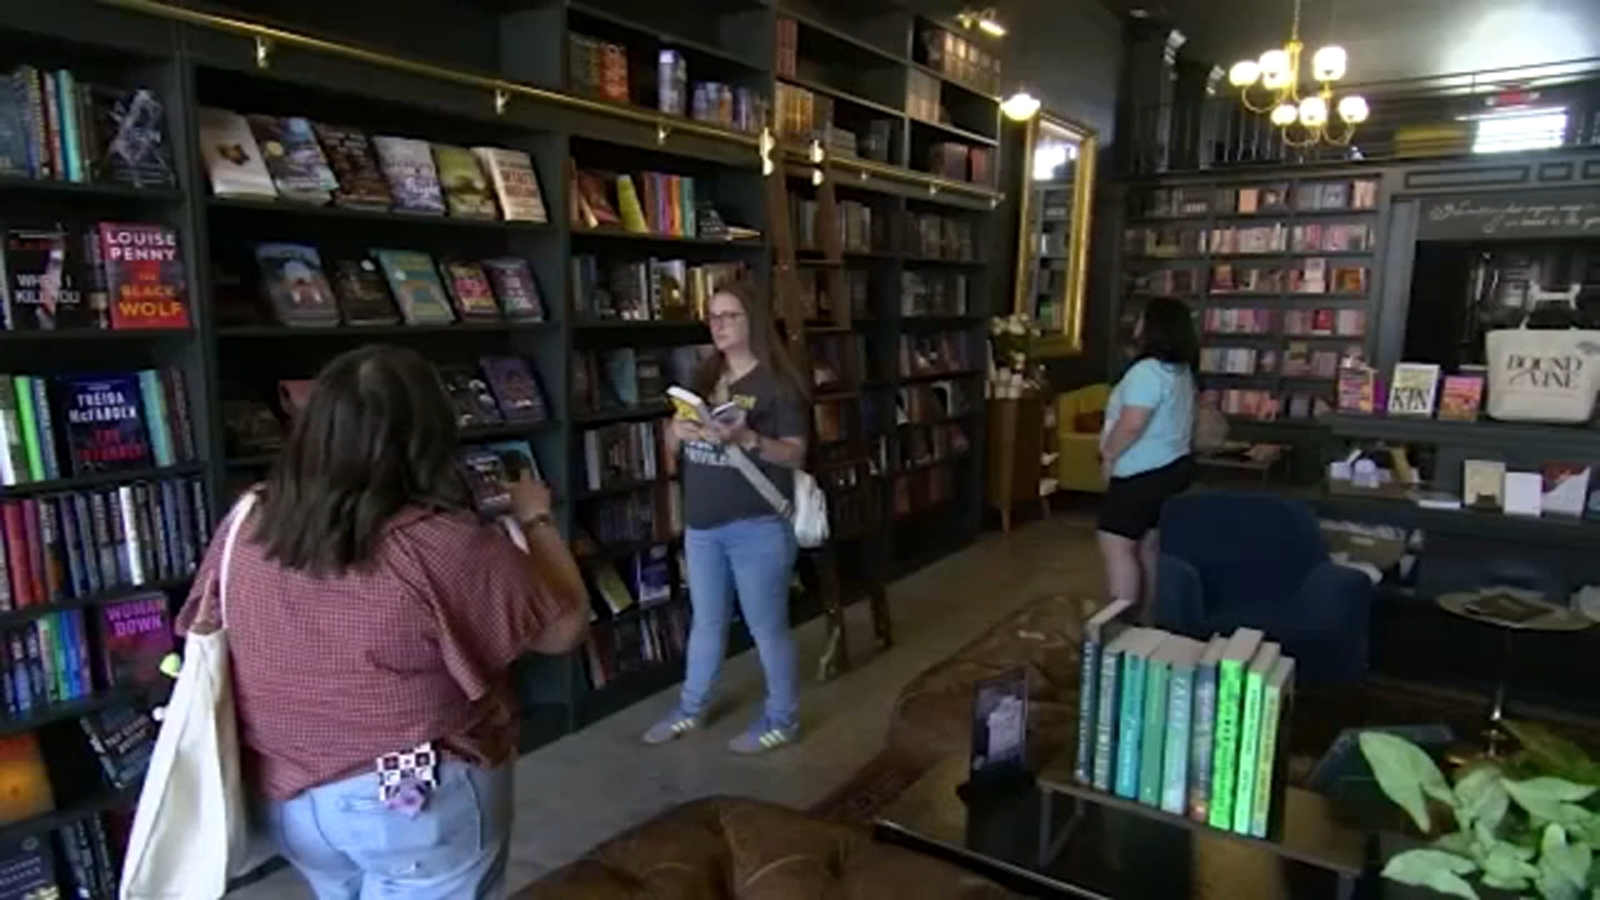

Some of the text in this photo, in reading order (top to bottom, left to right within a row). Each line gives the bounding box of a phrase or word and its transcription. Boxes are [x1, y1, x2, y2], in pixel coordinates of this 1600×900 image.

[105, 230, 176, 246] LOUISE
[110, 247, 175, 262] PENNY
[120, 285, 175, 297] BLACK
[118, 301, 183, 317] WOLF
[1507, 354, 1583, 371] BOUND
[1511, 370, 1580, 389] VINE
[76, 391, 126, 407] FREIDA
[114, 614, 163, 637] DOWN
